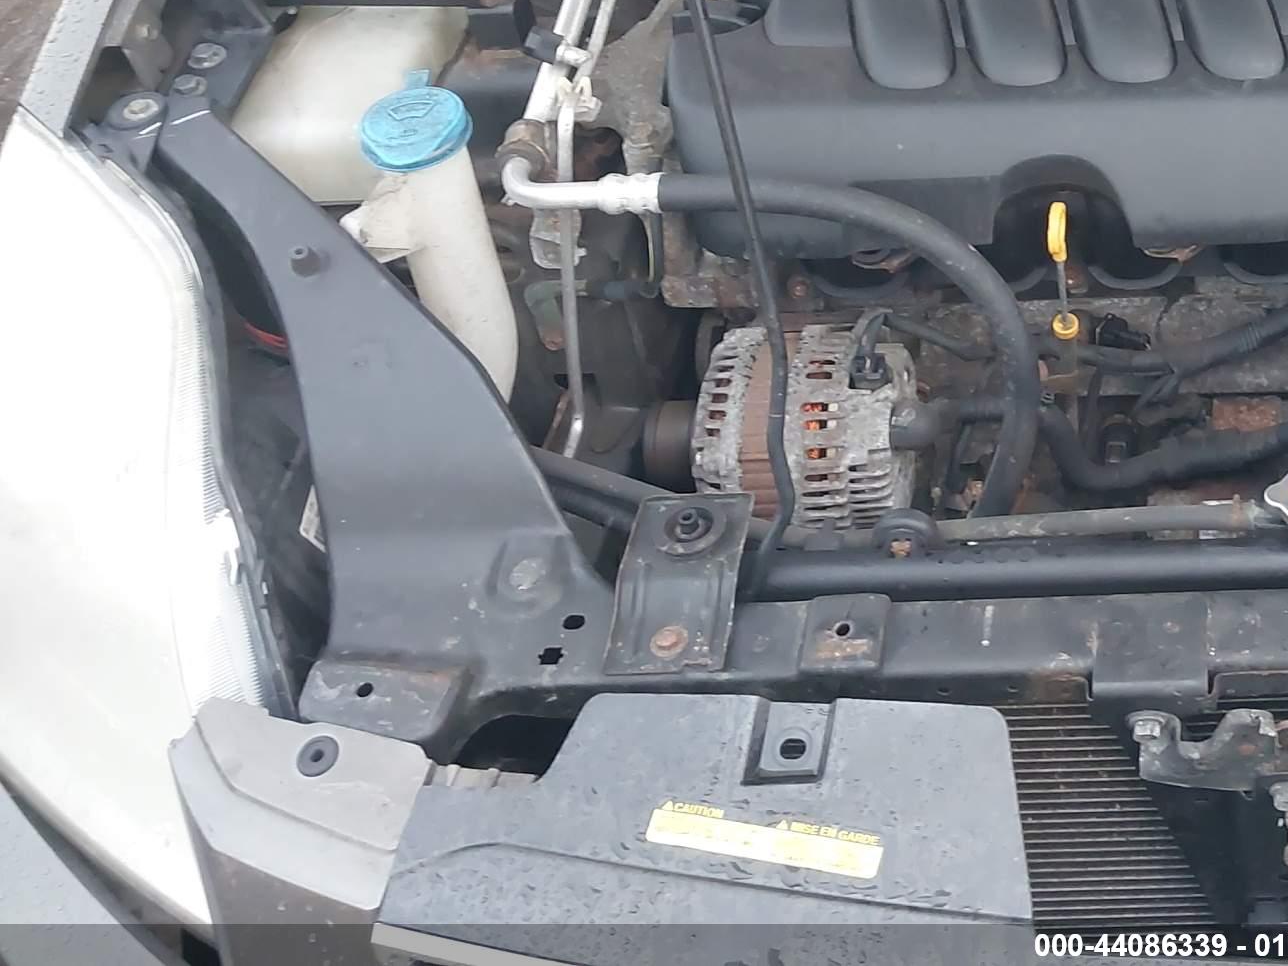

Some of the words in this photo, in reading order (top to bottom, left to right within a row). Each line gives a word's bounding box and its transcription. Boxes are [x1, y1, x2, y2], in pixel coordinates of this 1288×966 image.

[673, 802, 724, 819] CAUTION
[789, 820, 820, 836] MISE
[838, 830, 881, 846] GARDE
